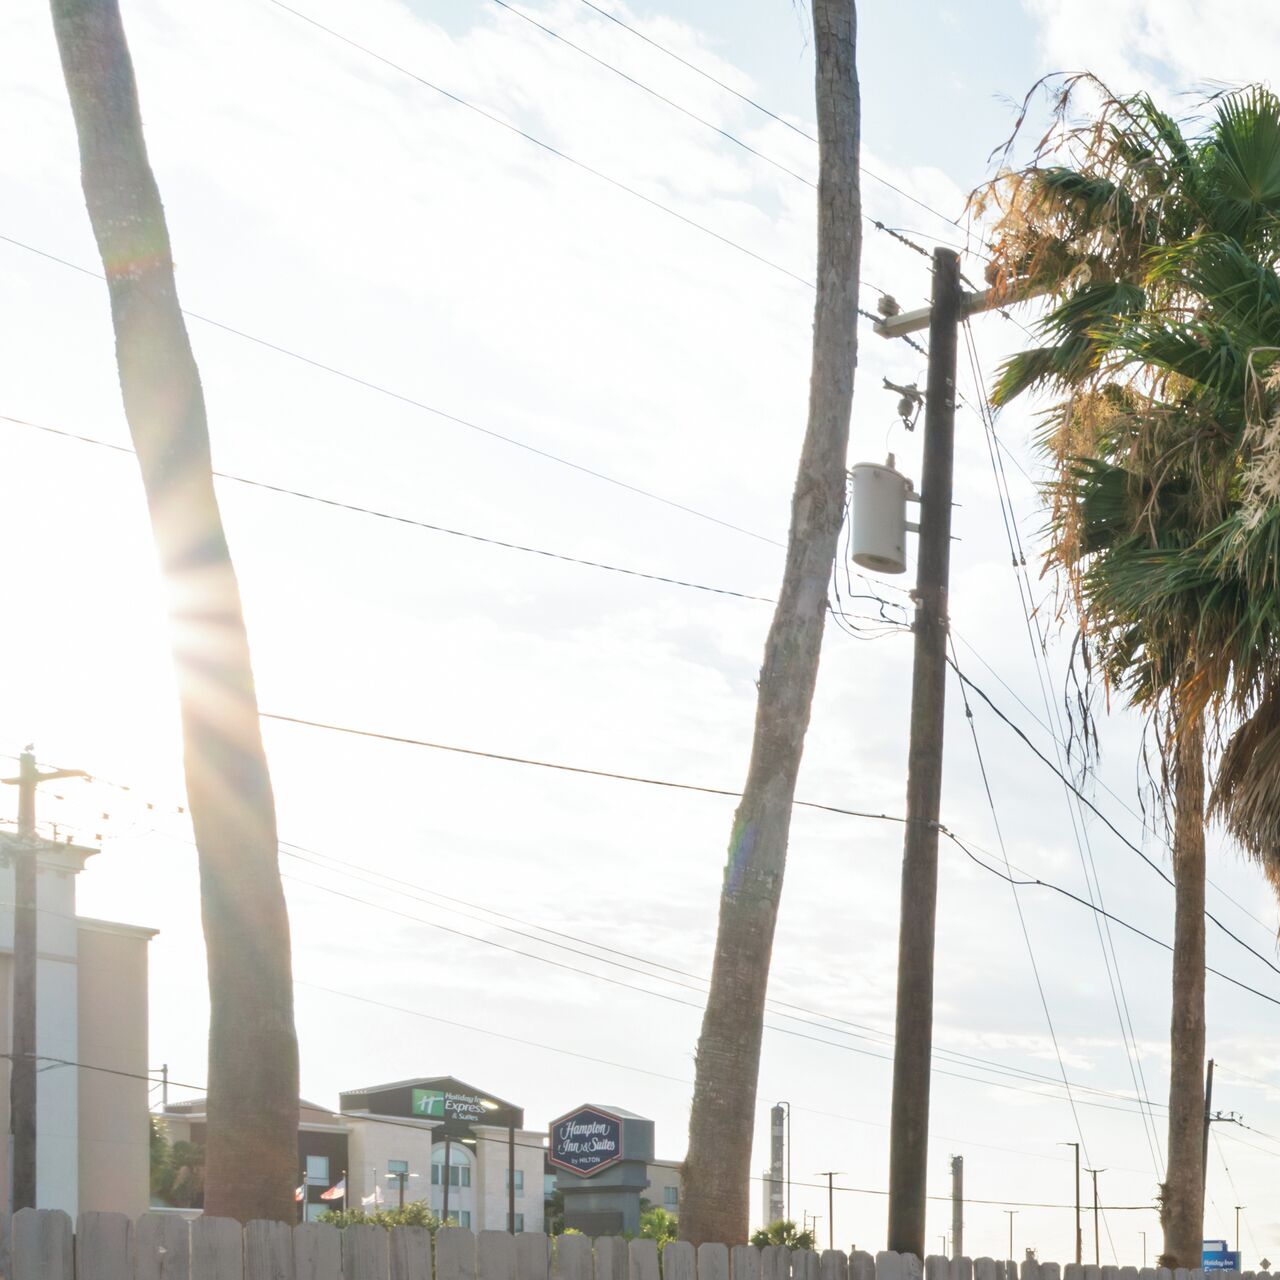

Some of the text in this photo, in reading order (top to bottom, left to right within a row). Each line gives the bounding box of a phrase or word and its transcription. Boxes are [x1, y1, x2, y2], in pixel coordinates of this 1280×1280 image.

[446, 1092, 474, 1103] Holiday
[445, 1101, 486, 1113] Express
[459, 1112, 479, 1121] Suites
[560, 1121, 610, 1140] Hampton
[558, 1139, 582, 1155] Inn
[588, 1137, 615, 1152] Suites
